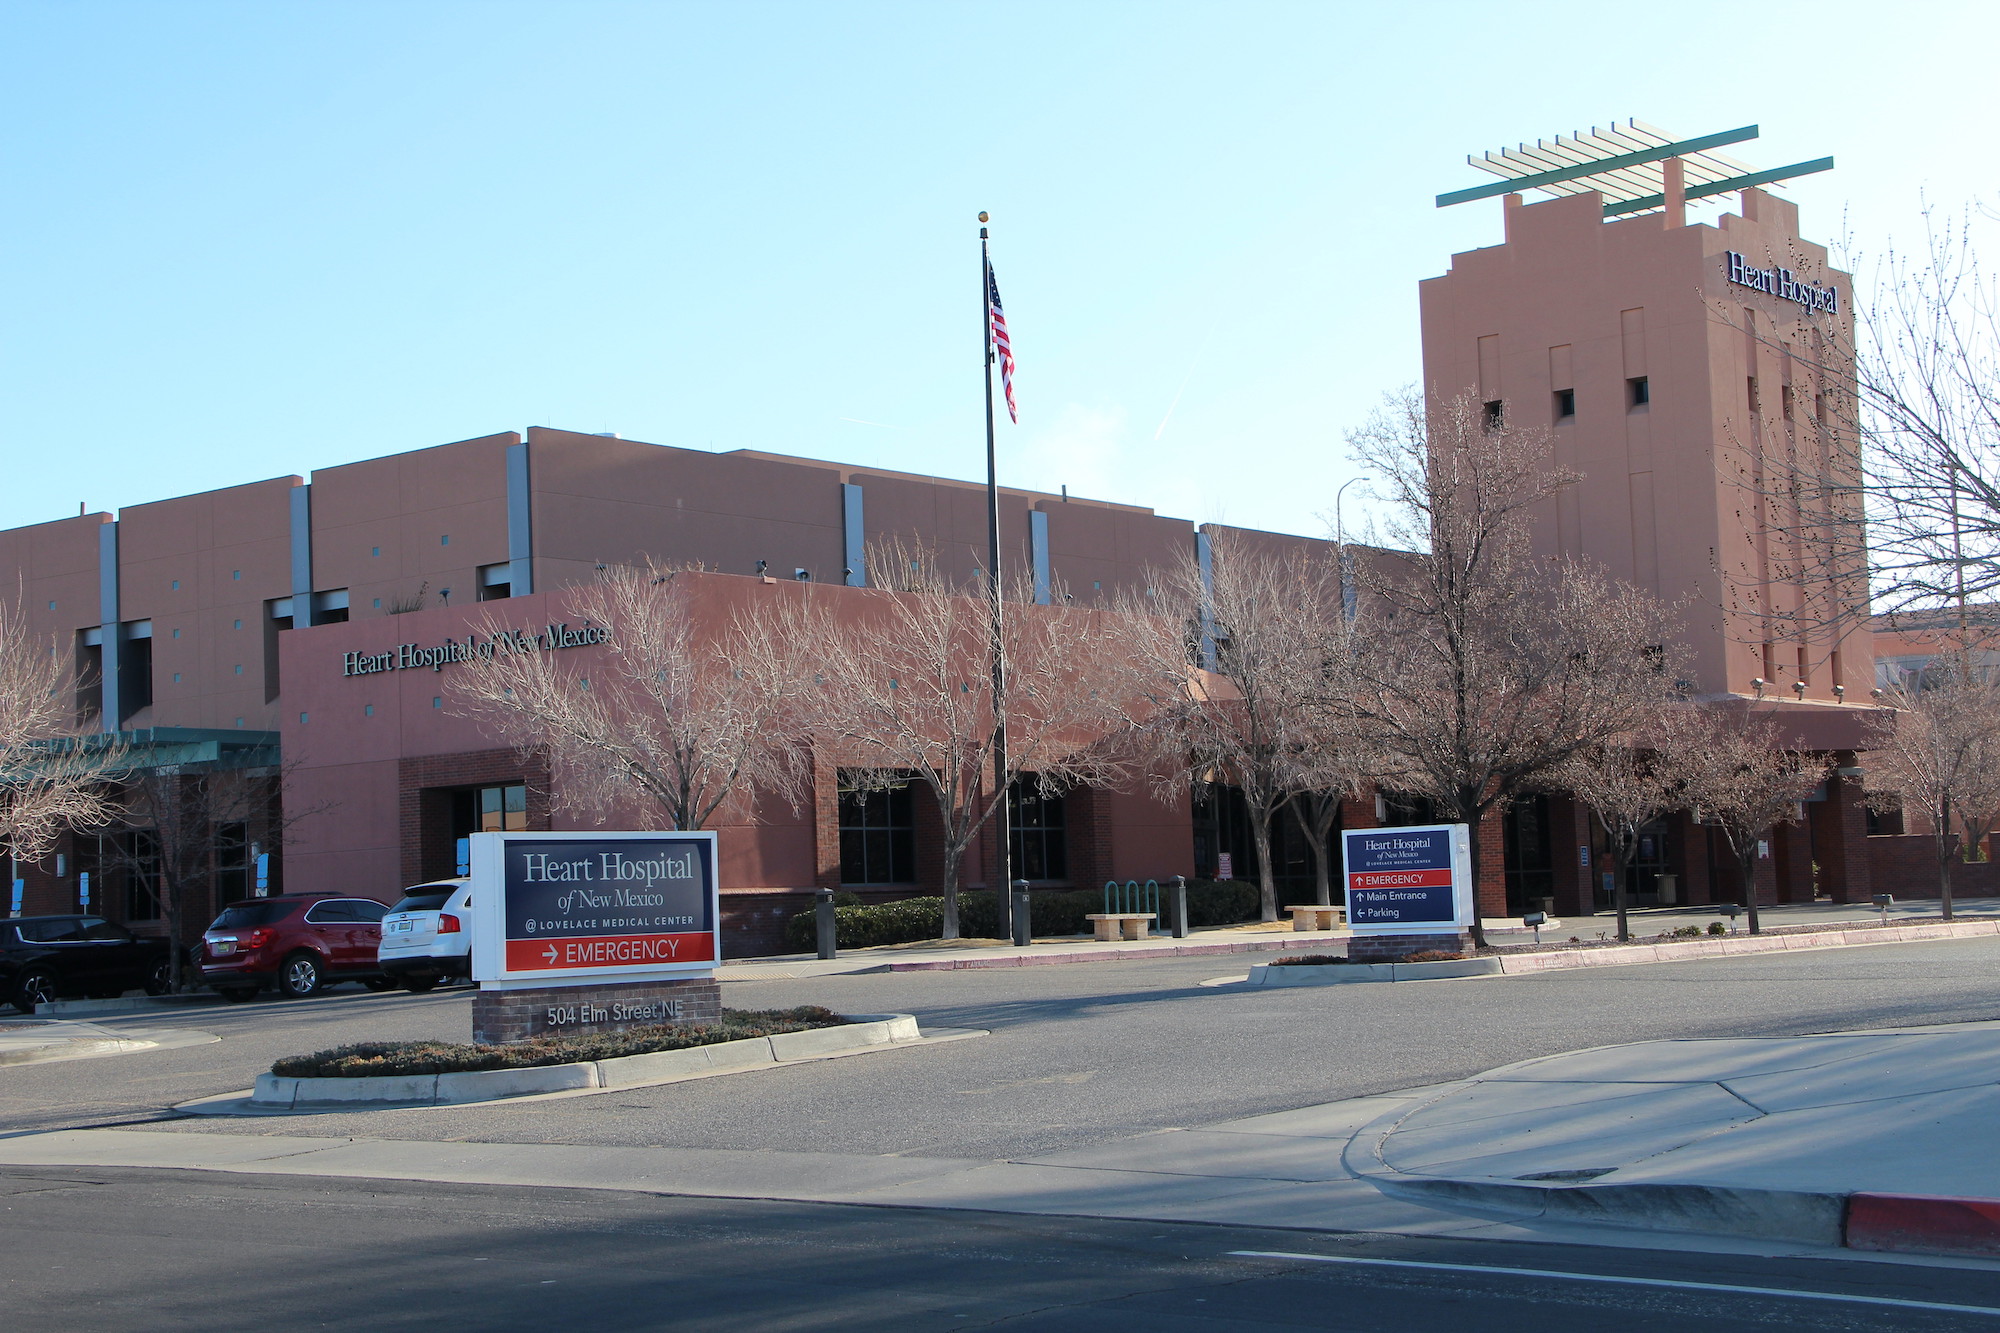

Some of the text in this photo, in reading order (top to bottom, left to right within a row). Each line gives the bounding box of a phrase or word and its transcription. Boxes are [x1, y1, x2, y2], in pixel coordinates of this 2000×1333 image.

[1726, 250, 1775, 295] Heart
[342, 620, 611, 676] Heart Hospital of New Mexico
[1365, 838, 1430, 851] Heart Hospital
[523, 852, 693, 887] Heart Hospital
[1366, 874, 1424, 885] EMERGENCY
[557, 888, 664, 915] of New Mexico
[1366, 891, 1427, 901] Main Entrance
[602, 917, 649, 928] MEDICAL
[654, 915, 694, 926] CENTER
[1367, 908, 1400, 919] Parking
[566, 939, 679, 963] EMERGENCY
[547, 1000, 684, 1025] 504 Elm Street NE
